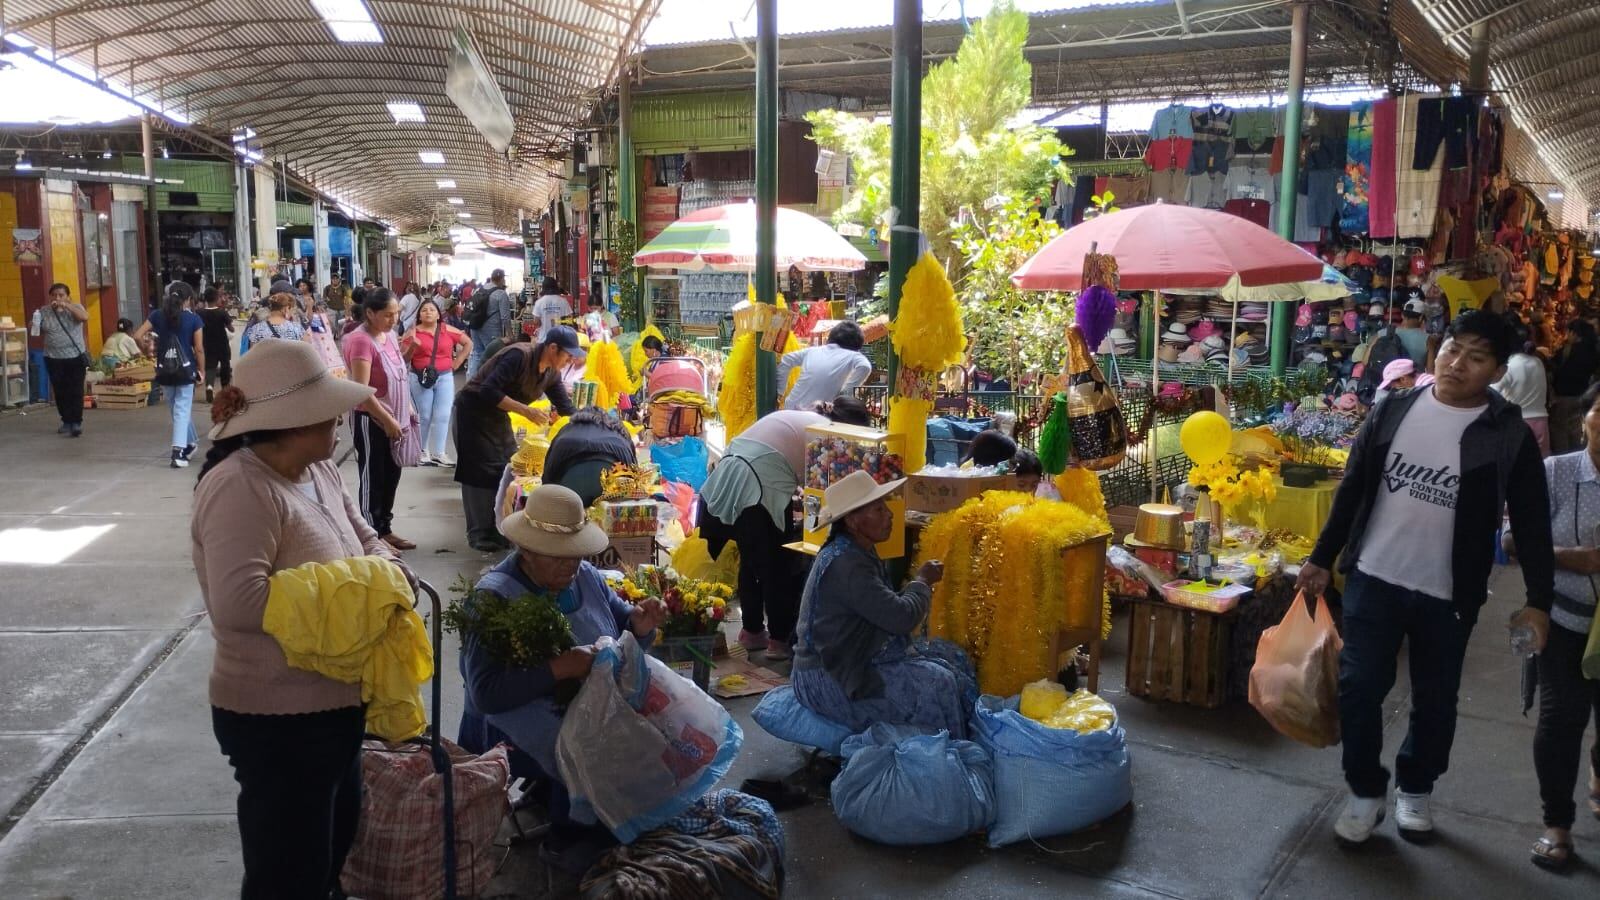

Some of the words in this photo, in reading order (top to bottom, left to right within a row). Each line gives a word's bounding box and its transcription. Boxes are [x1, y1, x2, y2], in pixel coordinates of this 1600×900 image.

[1383, 452, 1461, 489] Junto
[1409, 489, 1457, 510] VIOLENC
[1411, 481, 1454, 501] CONTRA
